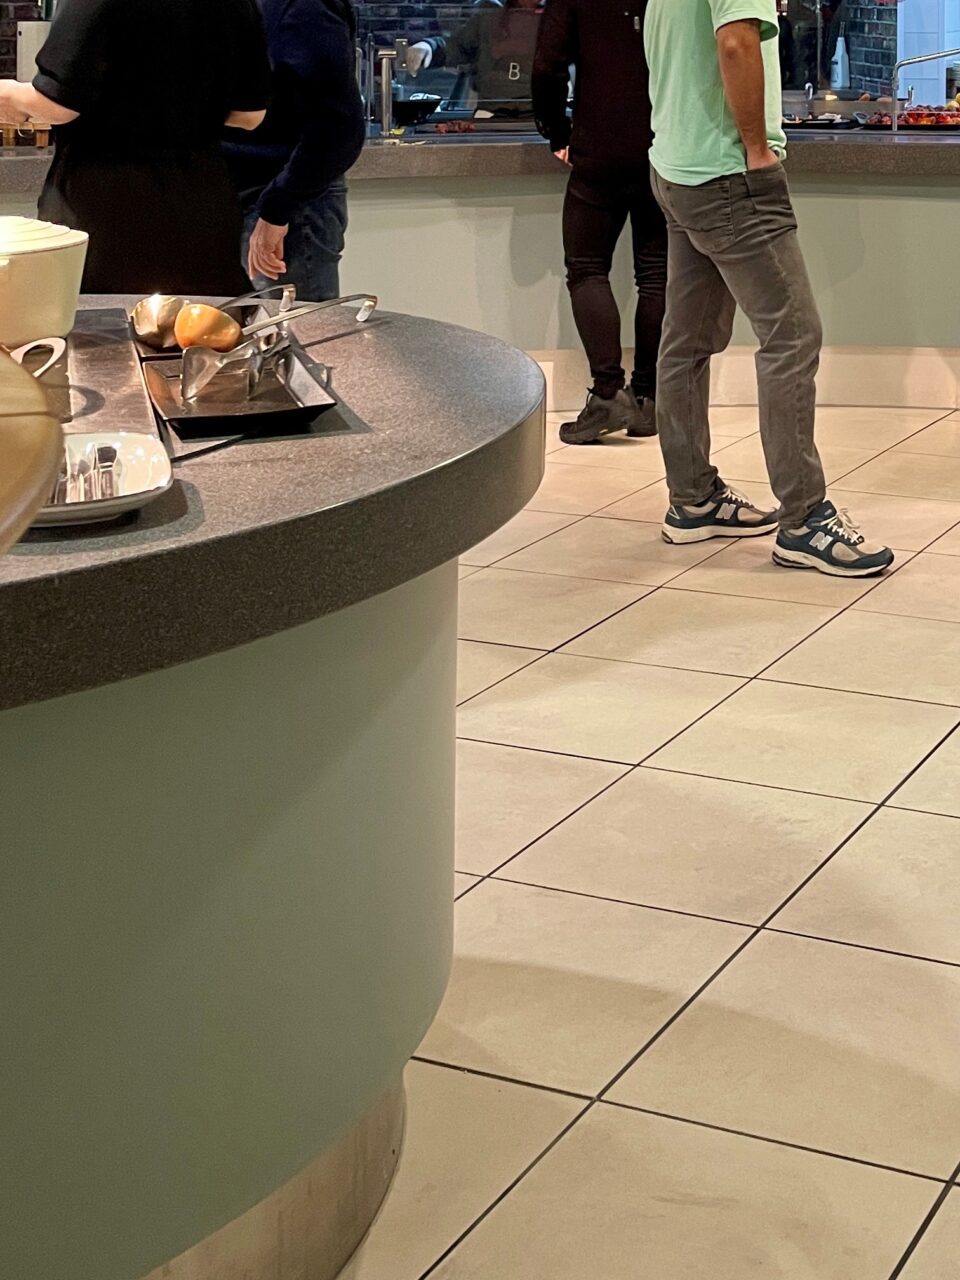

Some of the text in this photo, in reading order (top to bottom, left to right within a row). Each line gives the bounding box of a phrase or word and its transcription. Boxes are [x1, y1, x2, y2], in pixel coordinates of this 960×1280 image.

[508, 62, 521, 81] B
[715, 502, 736, 520] N
[808, 531, 834, 551] N
